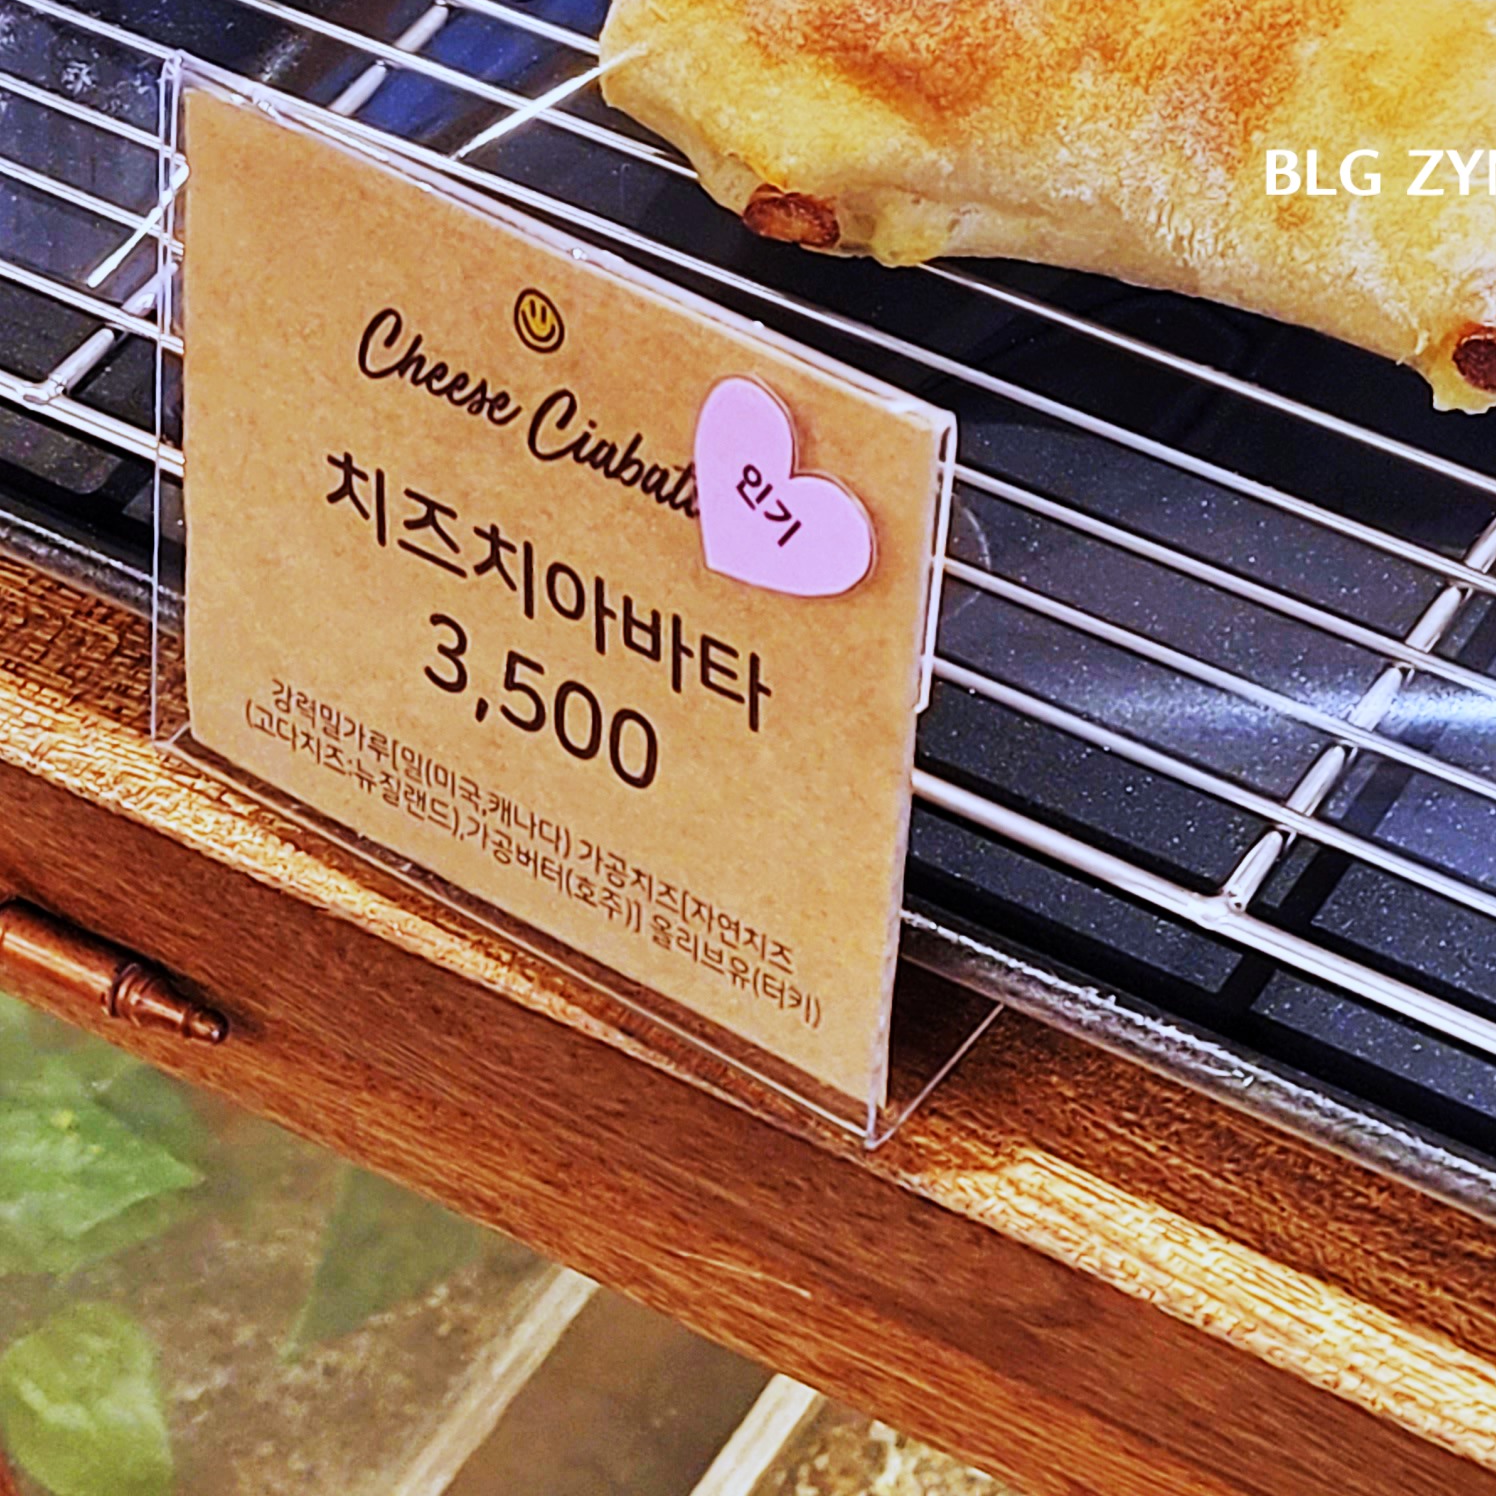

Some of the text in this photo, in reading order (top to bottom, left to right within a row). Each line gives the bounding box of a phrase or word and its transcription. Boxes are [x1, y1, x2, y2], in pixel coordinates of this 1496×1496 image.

[357, 307, 522, 426] Cheese
[735, 463, 803, 548] 인기
[326, 451, 773, 732] 치즈치아바타
[423, 612, 659, 790] 3,500
